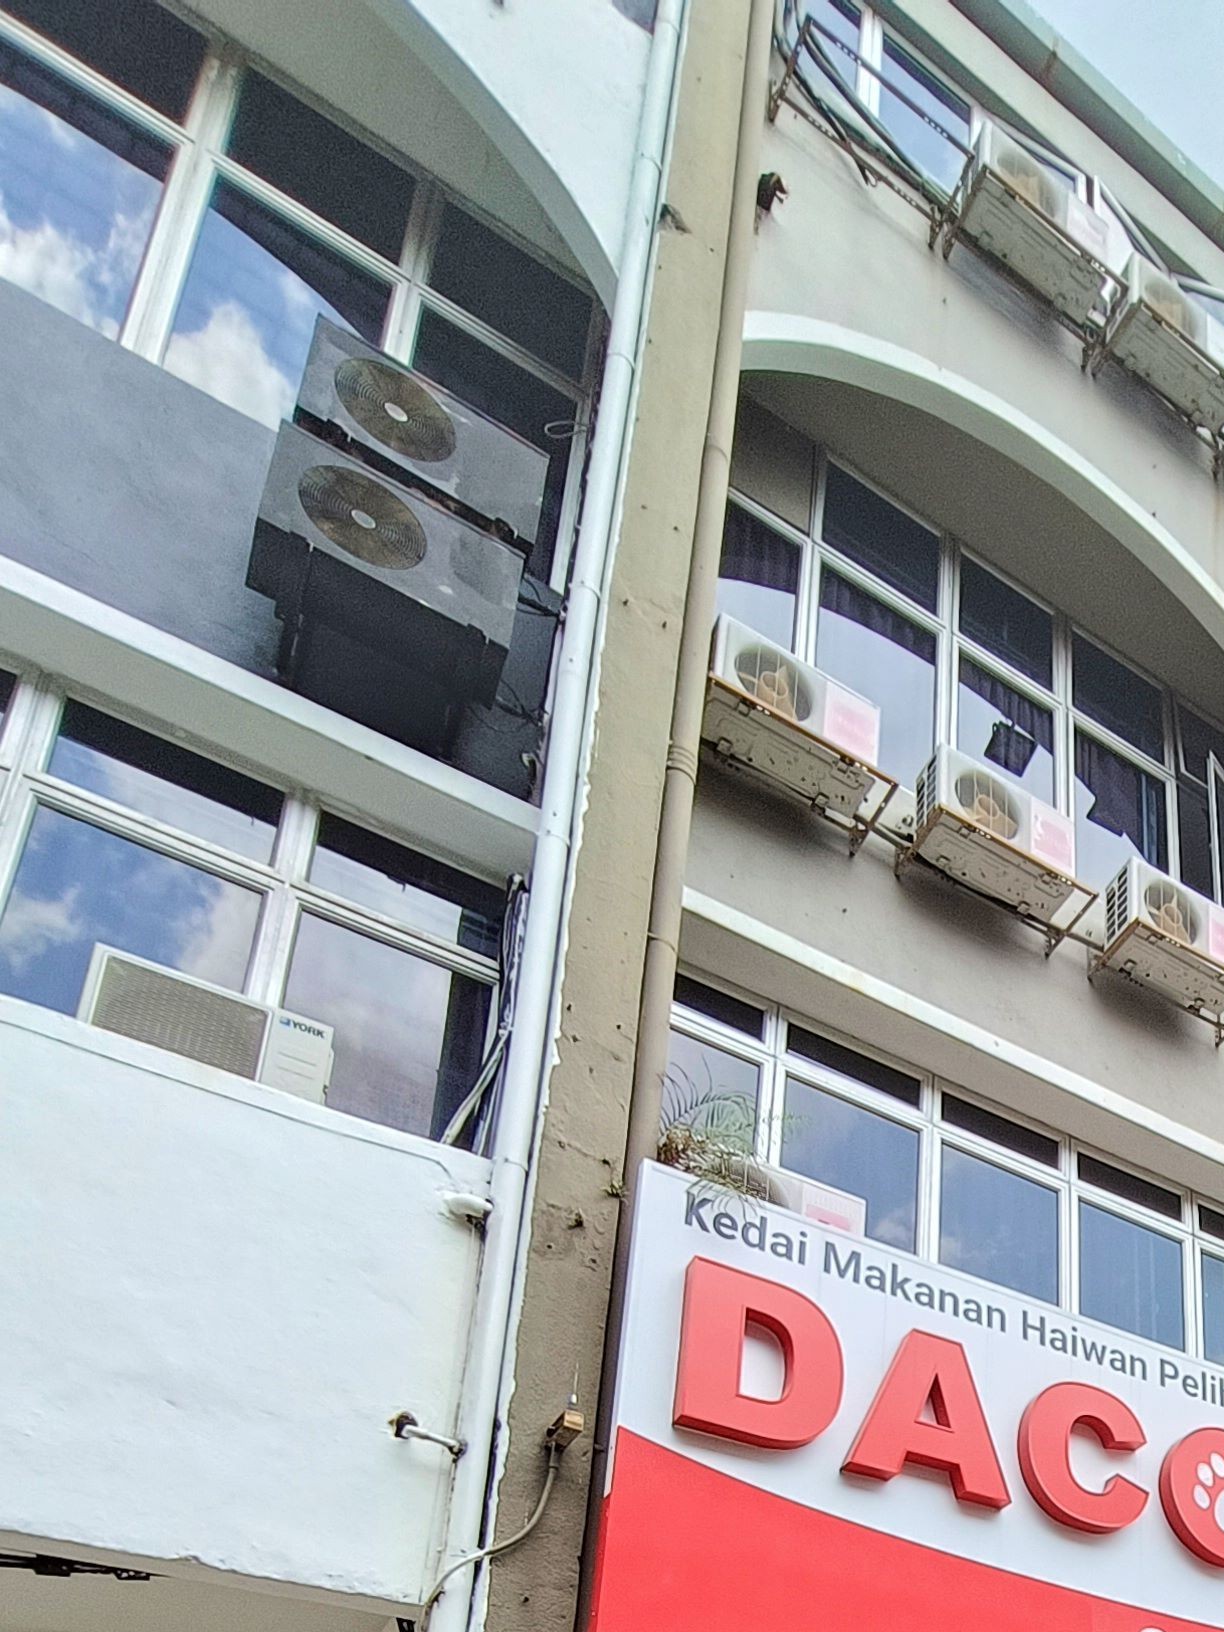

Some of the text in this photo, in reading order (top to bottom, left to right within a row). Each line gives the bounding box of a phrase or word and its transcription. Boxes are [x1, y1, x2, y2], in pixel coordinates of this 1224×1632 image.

[292, 1019, 325, 1039] YORK
[684, 1190, 808, 1266] Kedai
[823, 1240, 1007, 1333] Makanan
[1022, 1310, 1148, 1381] Haiwan
